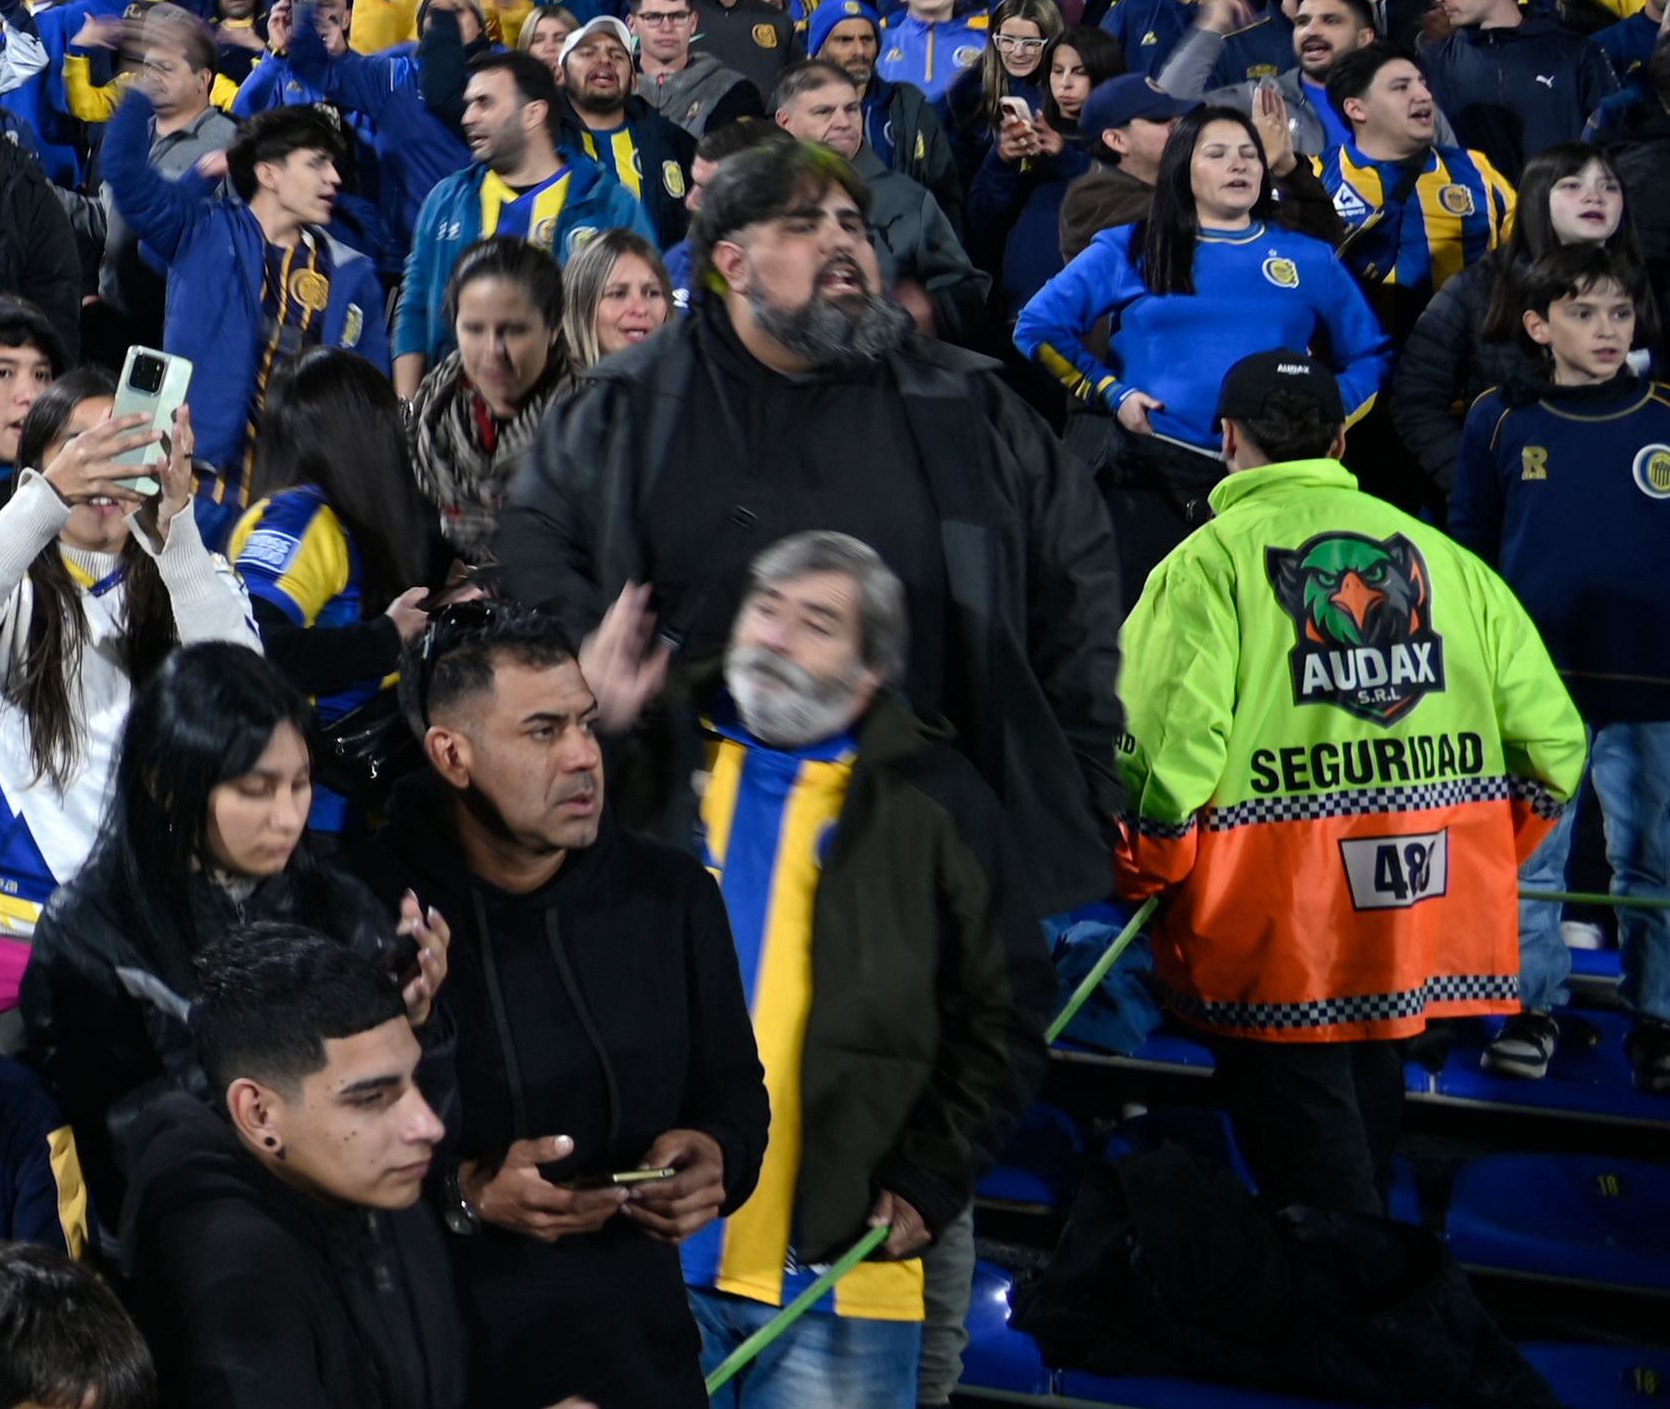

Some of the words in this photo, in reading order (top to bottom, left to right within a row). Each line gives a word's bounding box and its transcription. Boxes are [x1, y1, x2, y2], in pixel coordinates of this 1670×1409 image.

[1302, 642, 1436, 695] AUDAX
[1249, 732, 1484, 794] SEGURIDAD
[1374, 842, 1430, 900] 48
